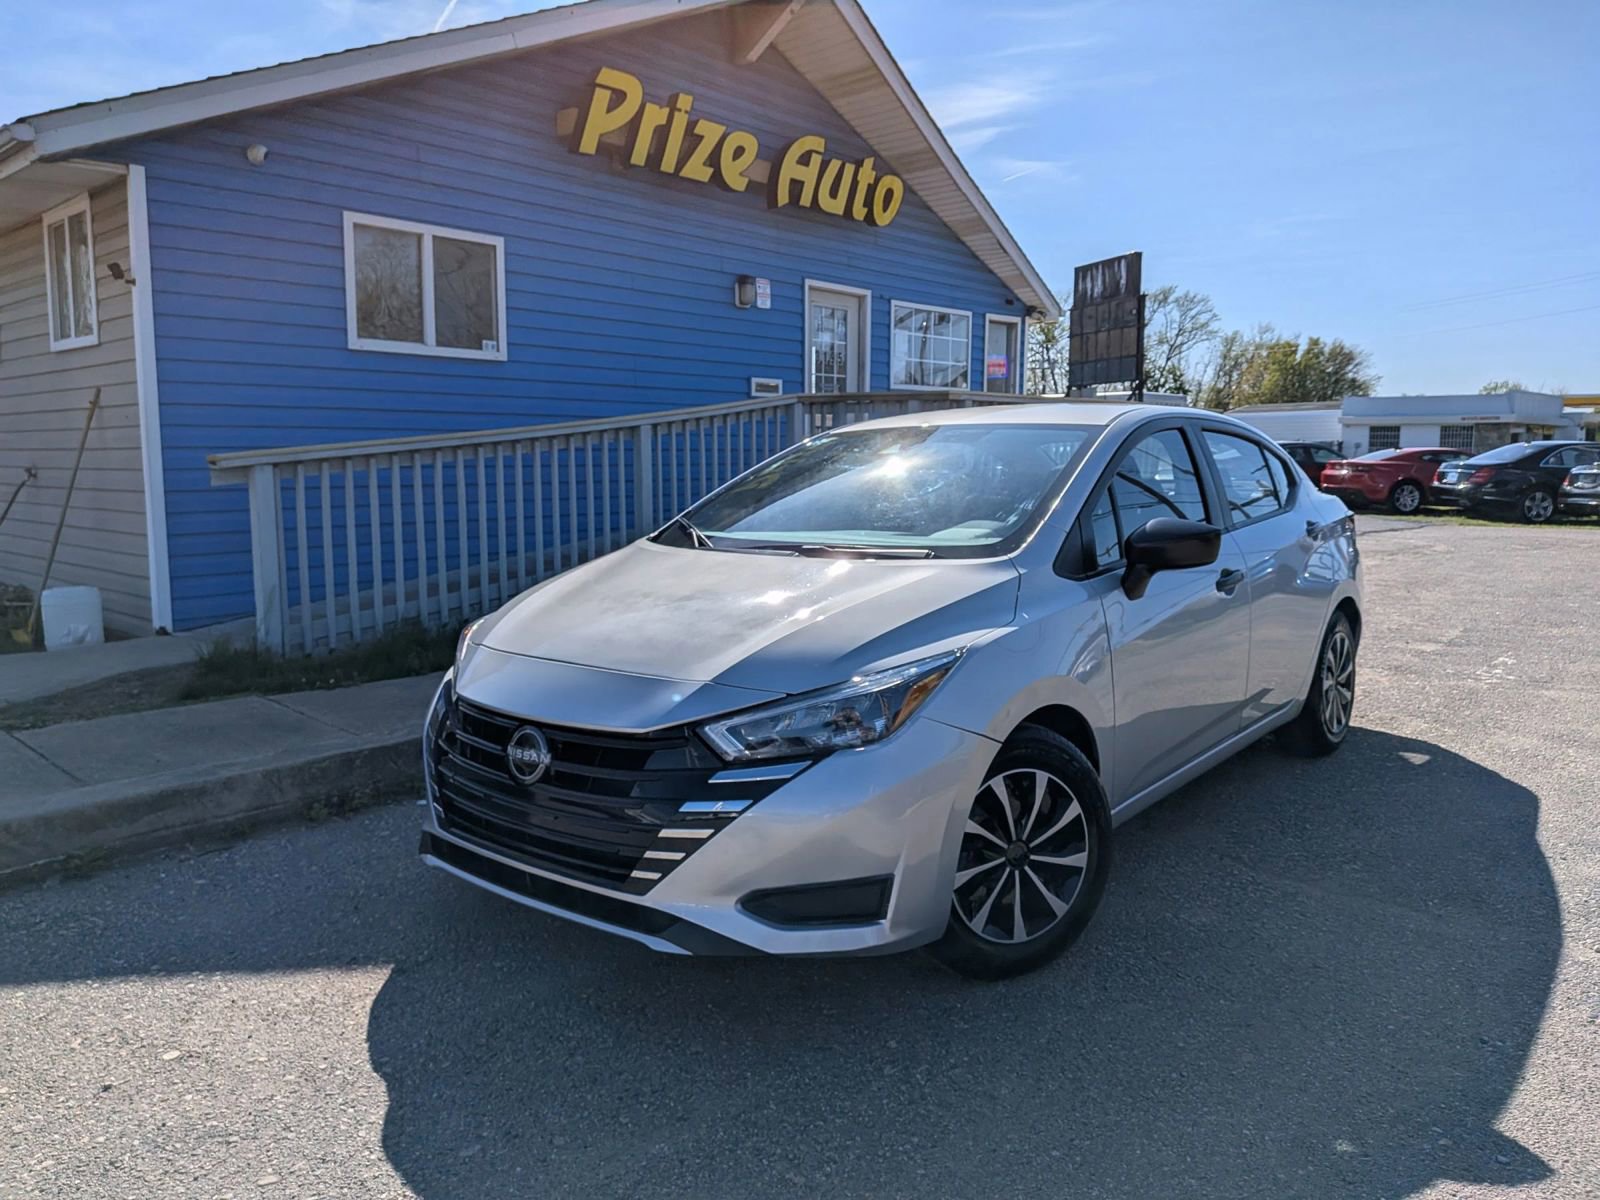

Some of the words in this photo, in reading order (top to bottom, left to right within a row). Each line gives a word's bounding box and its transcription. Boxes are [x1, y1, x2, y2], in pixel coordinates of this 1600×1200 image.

[578, 67, 759, 192] Prize
[776, 135, 904, 226] Auto
[508, 746, 551, 765] NISSAN
